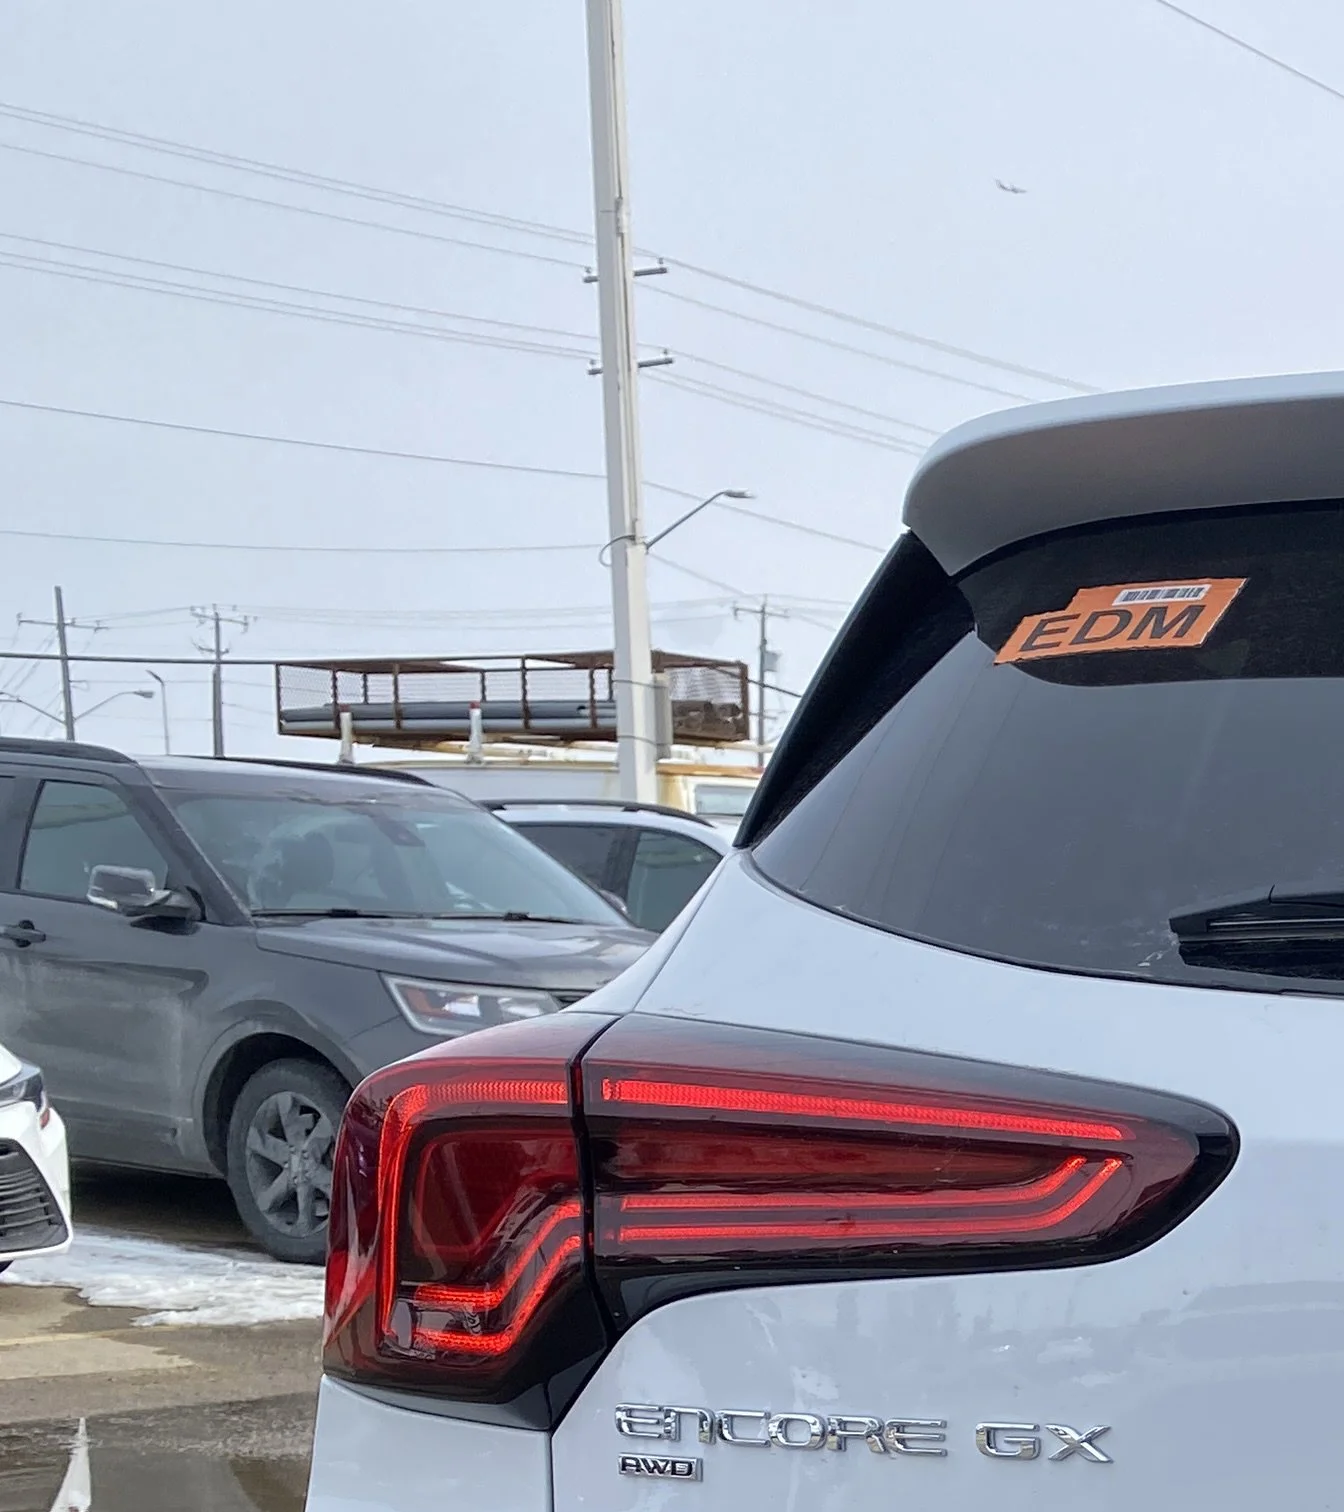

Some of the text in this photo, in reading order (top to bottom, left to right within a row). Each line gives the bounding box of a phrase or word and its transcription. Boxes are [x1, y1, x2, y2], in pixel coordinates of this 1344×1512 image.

[1018, 604, 1206, 651] EDM
[614, 1402, 1113, 1464] ENCORE GX
[621, 1456, 694, 1477] AWD
